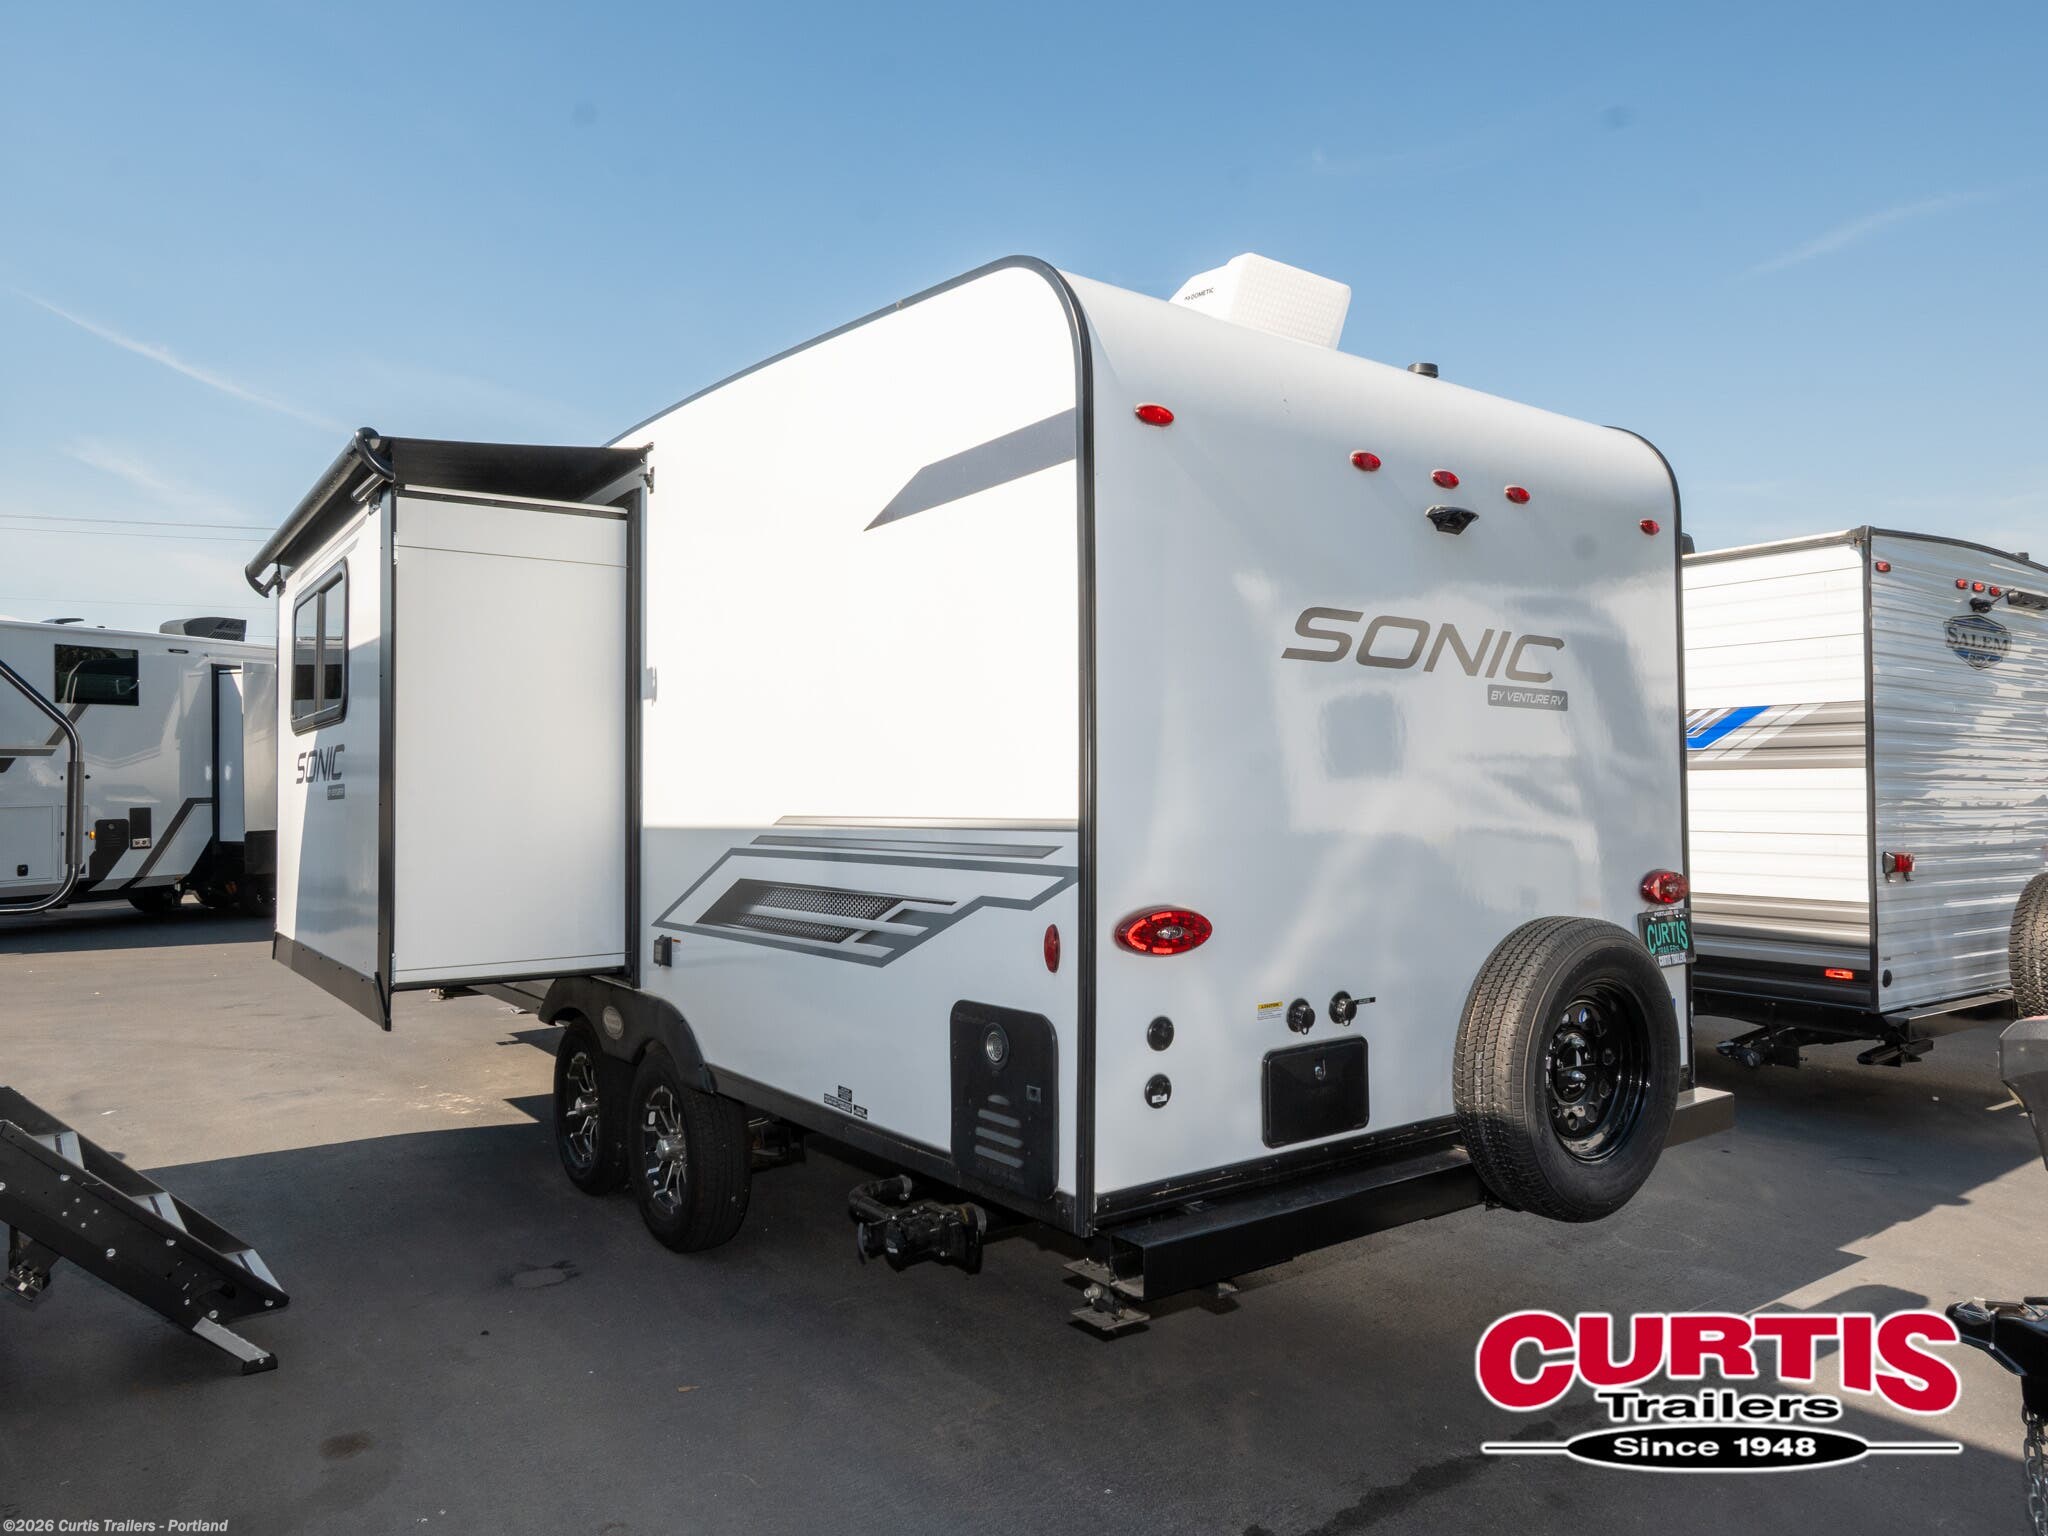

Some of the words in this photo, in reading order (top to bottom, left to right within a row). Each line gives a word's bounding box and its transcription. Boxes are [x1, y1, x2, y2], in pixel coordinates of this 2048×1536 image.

[1281, 606, 1565, 683] SONIC
[1490, 690, 1506, 701] BY
[1507, 692, 1550, 705] VENTURE
[1550, 695, 1565, 706] RV
[296, 744, 345, 784] SONIC
[1647, 920, 1689, 955] CURTIS
[1658, 945, 1680, 954] TRAILERS
